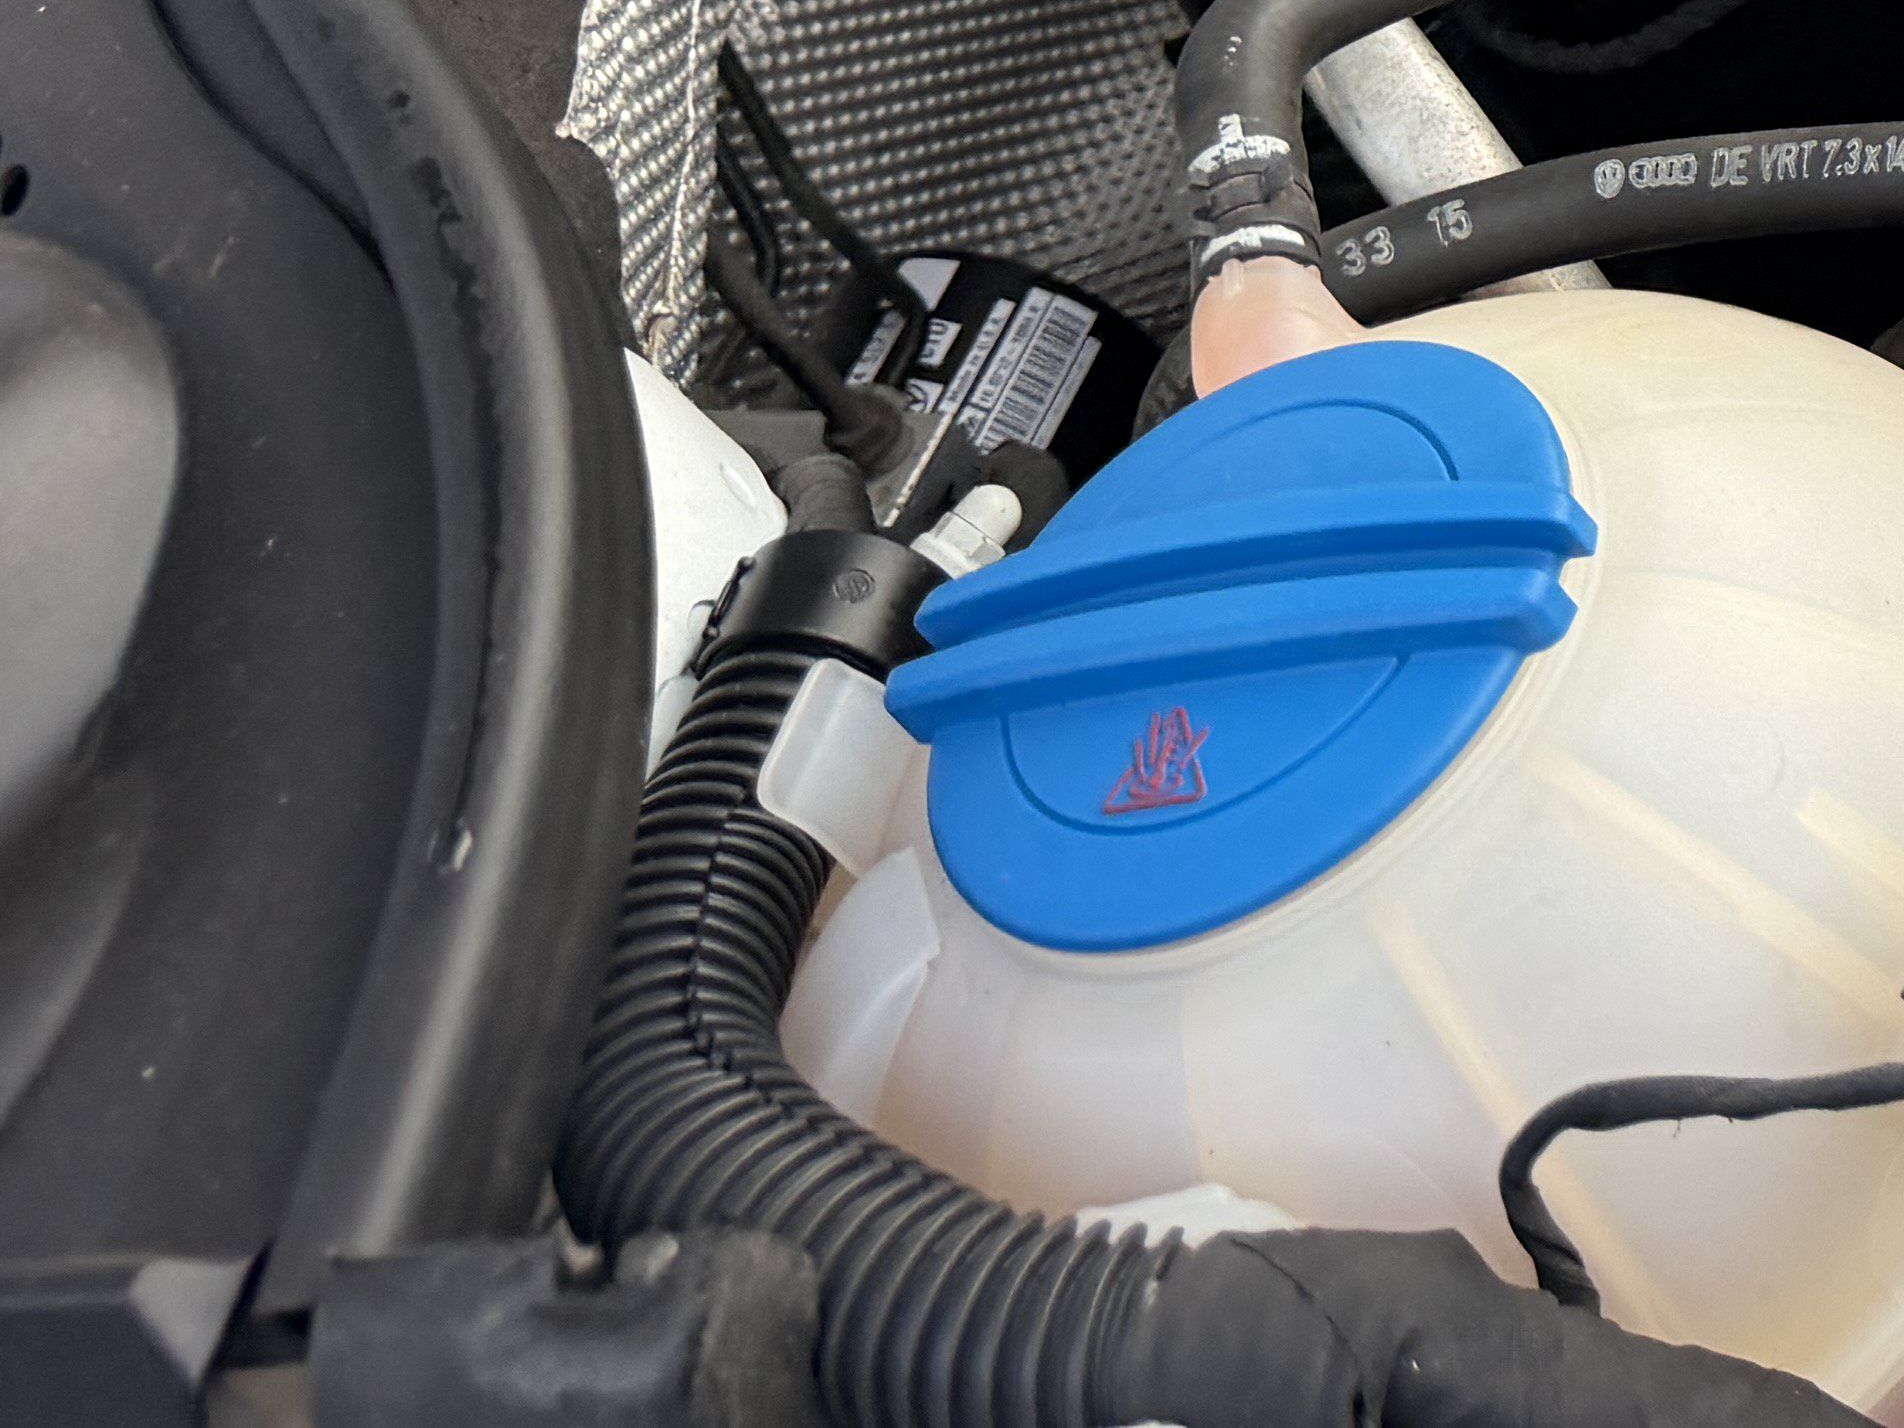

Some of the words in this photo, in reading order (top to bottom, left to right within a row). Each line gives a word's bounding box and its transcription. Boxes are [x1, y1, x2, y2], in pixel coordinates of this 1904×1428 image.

[1335, 225, 1395, 277] 33
[1426, 198, 1474, 248] 15
[1711, 149, 1751, 189] DE
[1760, 139, 1818, 184] VRT
